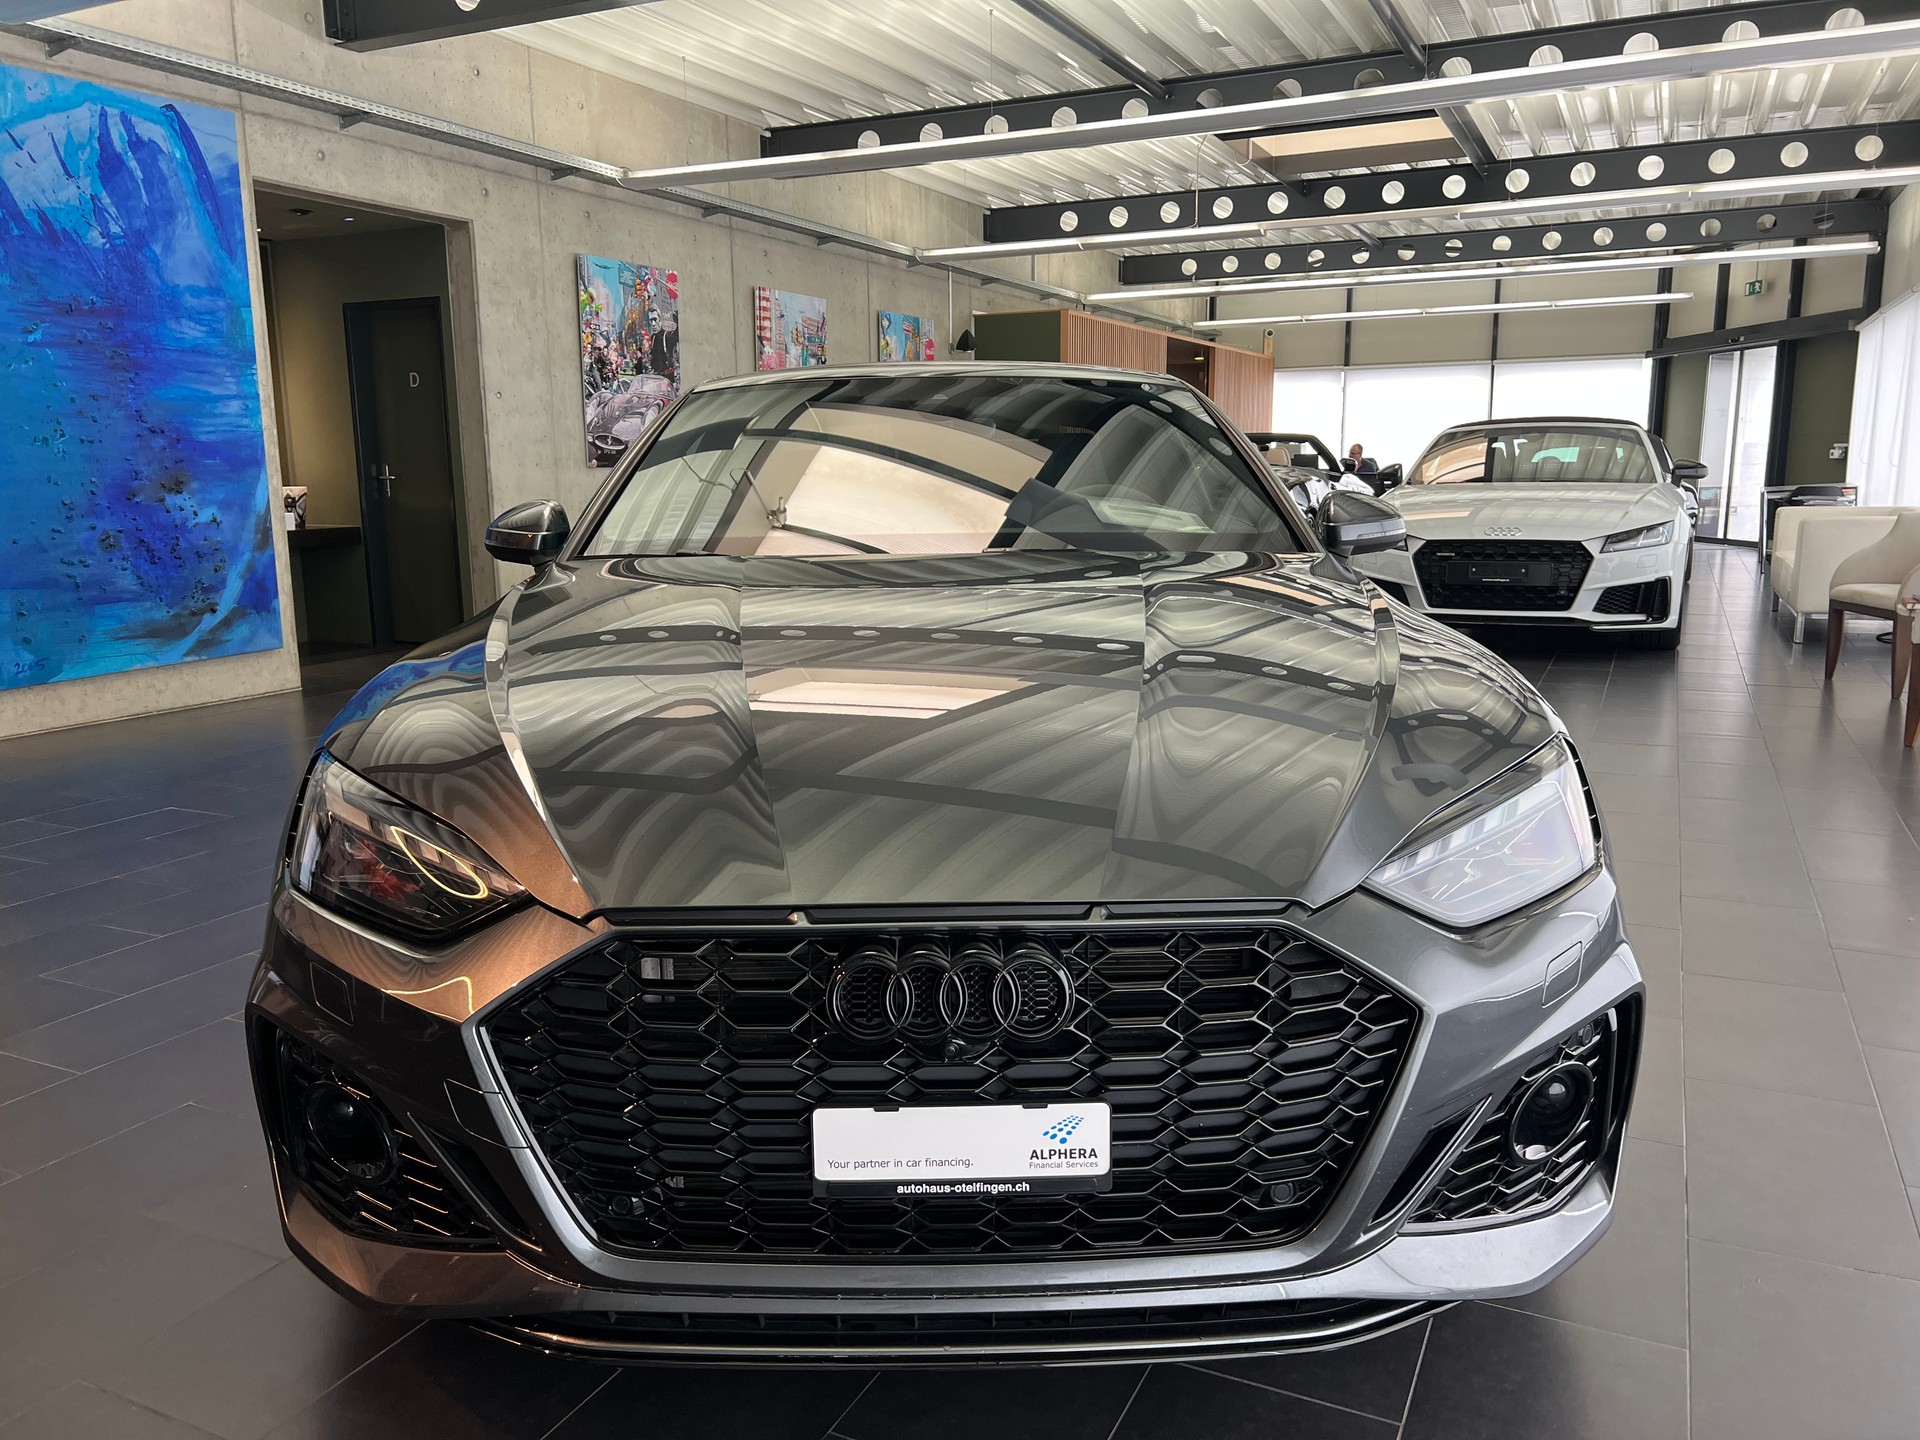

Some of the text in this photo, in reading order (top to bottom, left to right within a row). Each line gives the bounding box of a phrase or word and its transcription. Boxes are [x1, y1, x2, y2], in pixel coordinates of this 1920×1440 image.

[410, 372, 420, 388] D
[1029, 1148, 1098, 1160] ALPHERA
[827, 1157, 974, 1170] Your partner in car financing.
[1029, 1160, 1099, 1169] Financial Services
[896, 1181, 1030, 1194] autohaus-otelfingen.ch
